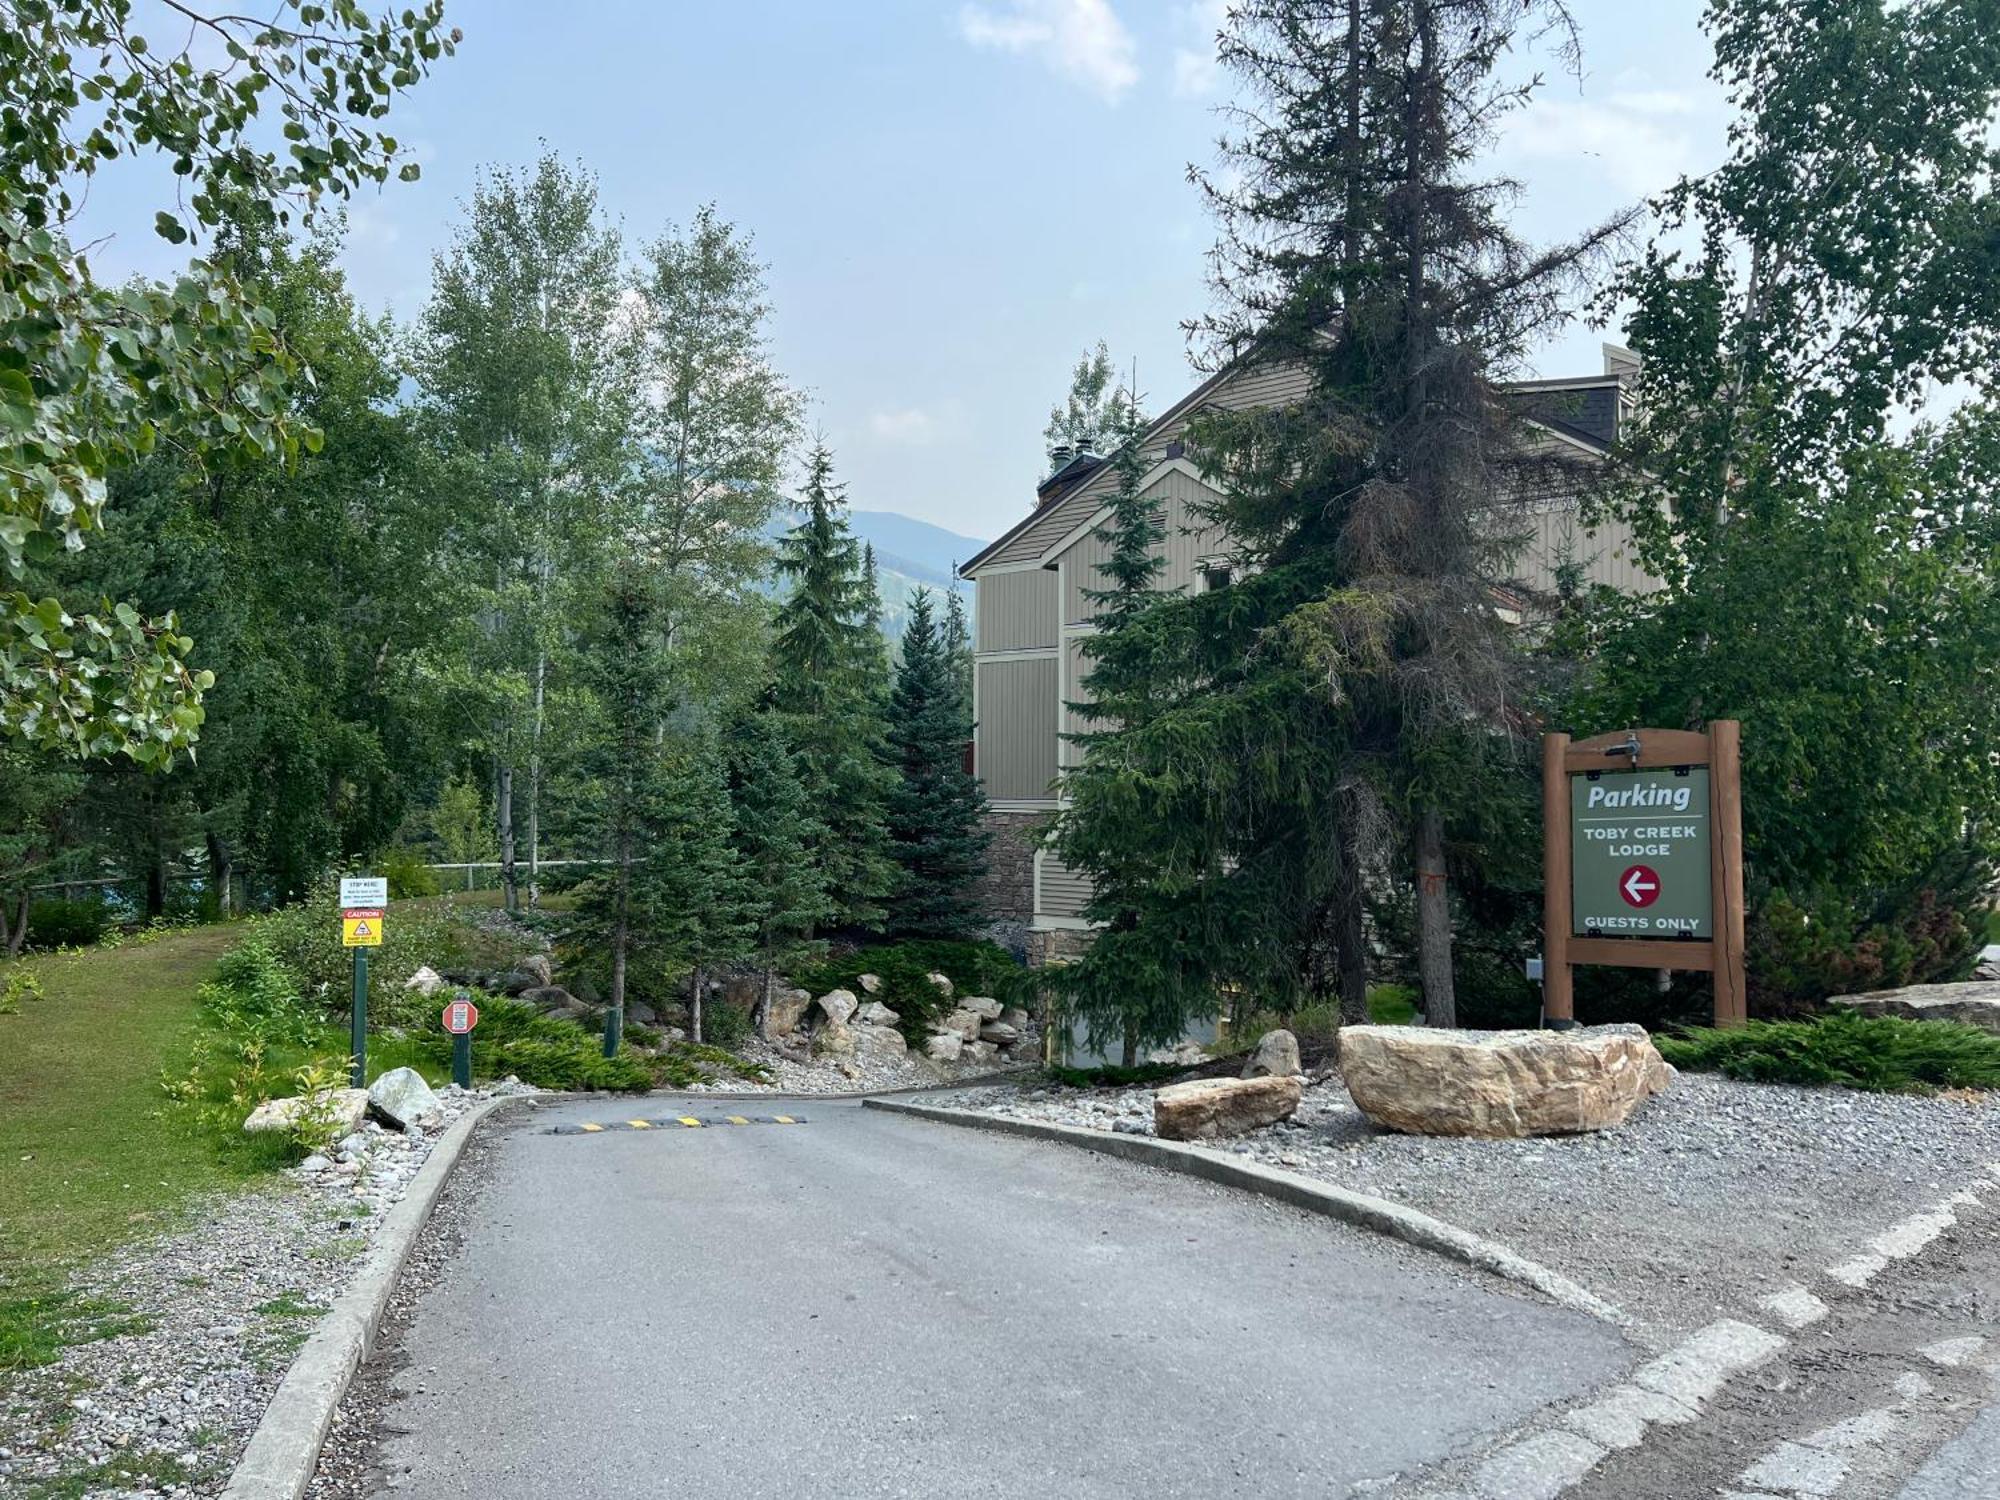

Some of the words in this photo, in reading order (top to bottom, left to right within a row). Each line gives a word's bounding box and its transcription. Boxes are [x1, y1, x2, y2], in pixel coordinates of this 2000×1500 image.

[1588, 783, 1690, 811] Parking
[1584, 827, 1629, 840] TOBY
[1634, 826, 1696, 838] CREEK
[1609, 844, 1670, 856] LODGE
[1584, 917, 1648, 928] GUESTS
[1656, 918, 1700, 930] ONLY
